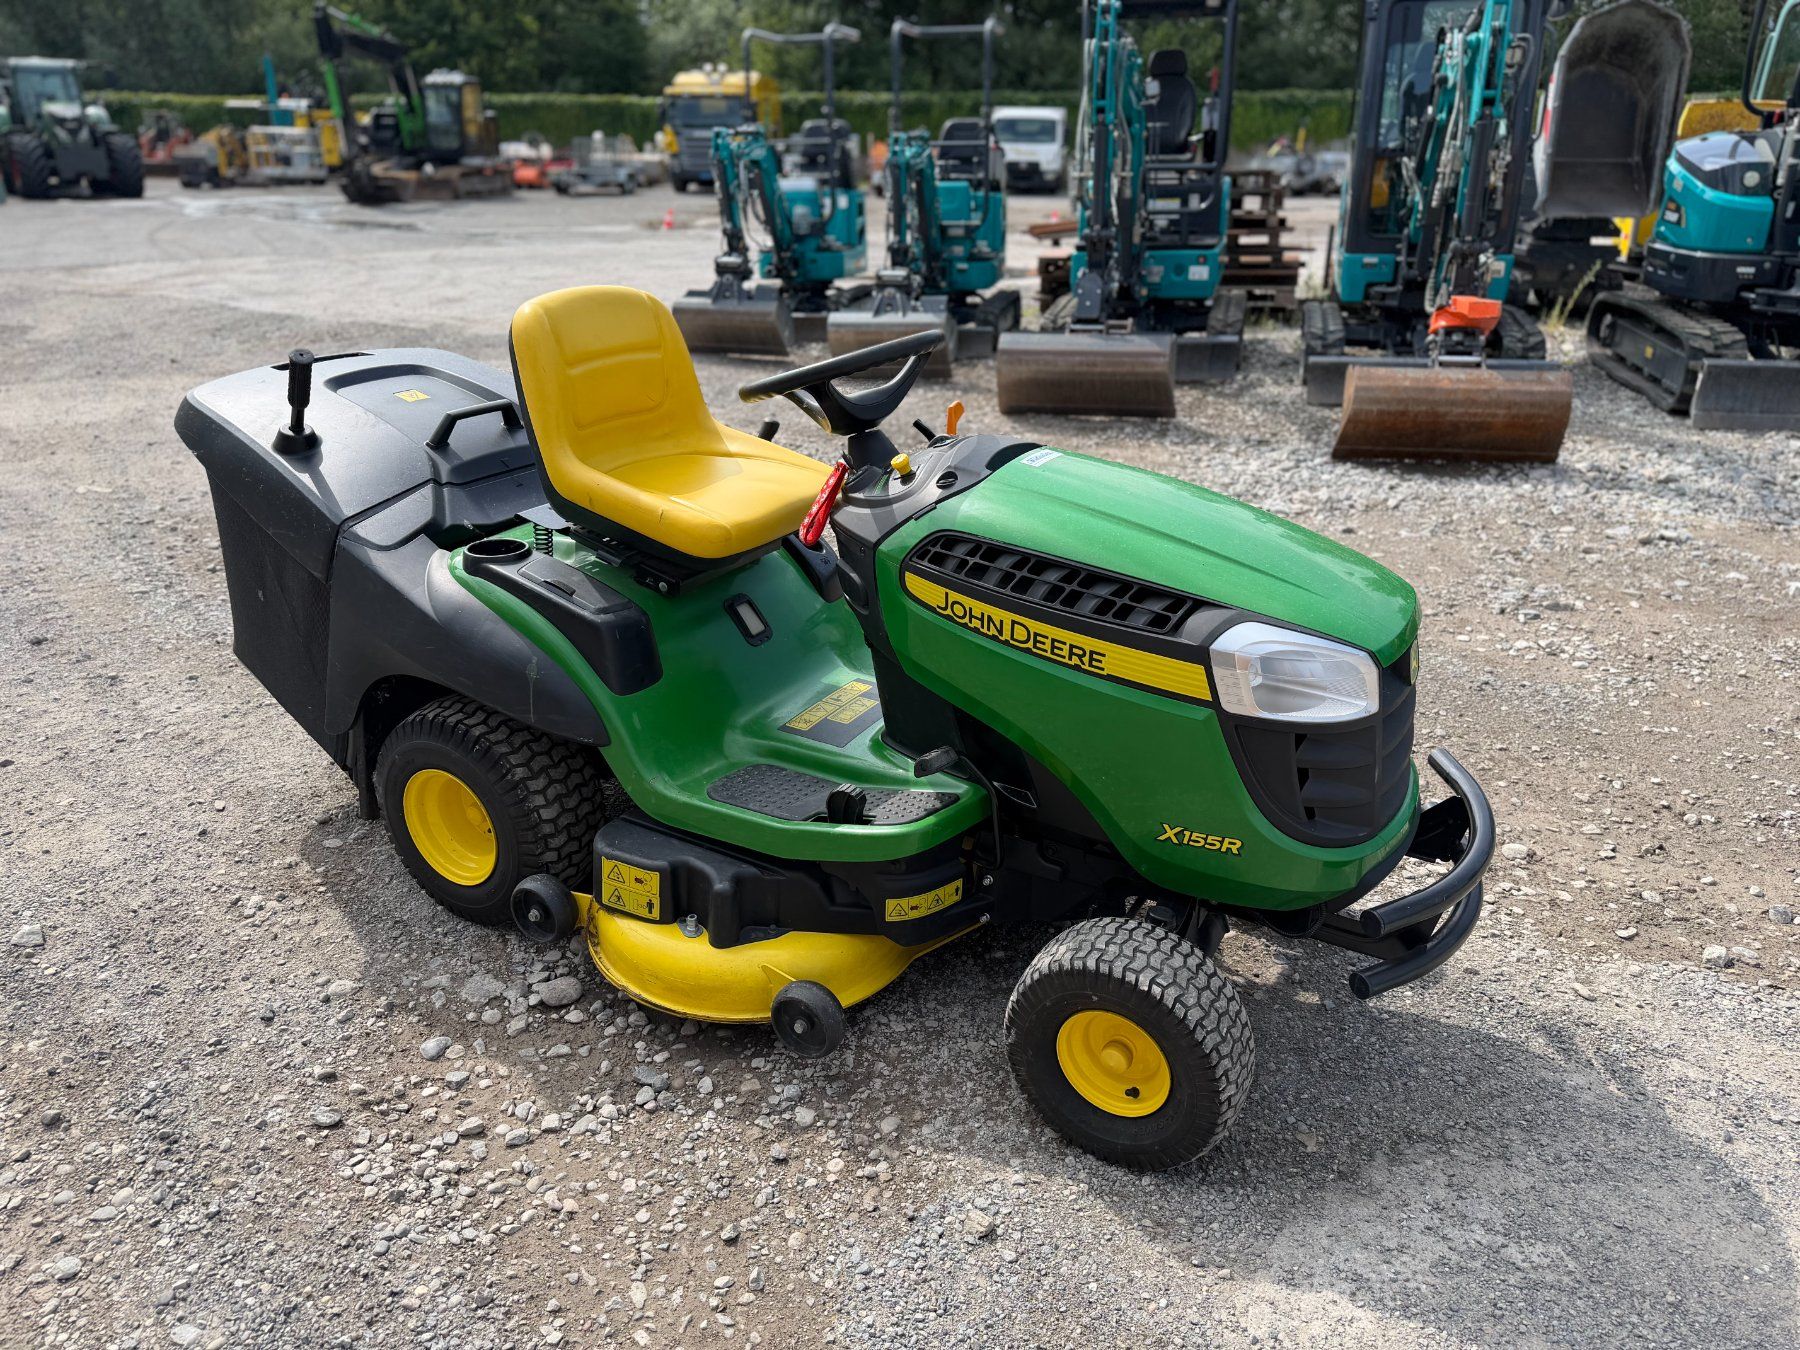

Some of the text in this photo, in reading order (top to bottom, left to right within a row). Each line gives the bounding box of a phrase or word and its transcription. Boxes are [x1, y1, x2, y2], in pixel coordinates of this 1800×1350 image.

[936, 591, 1107, 672] JOHN DEERE
[1156, 823, 1243, 855] X155R
